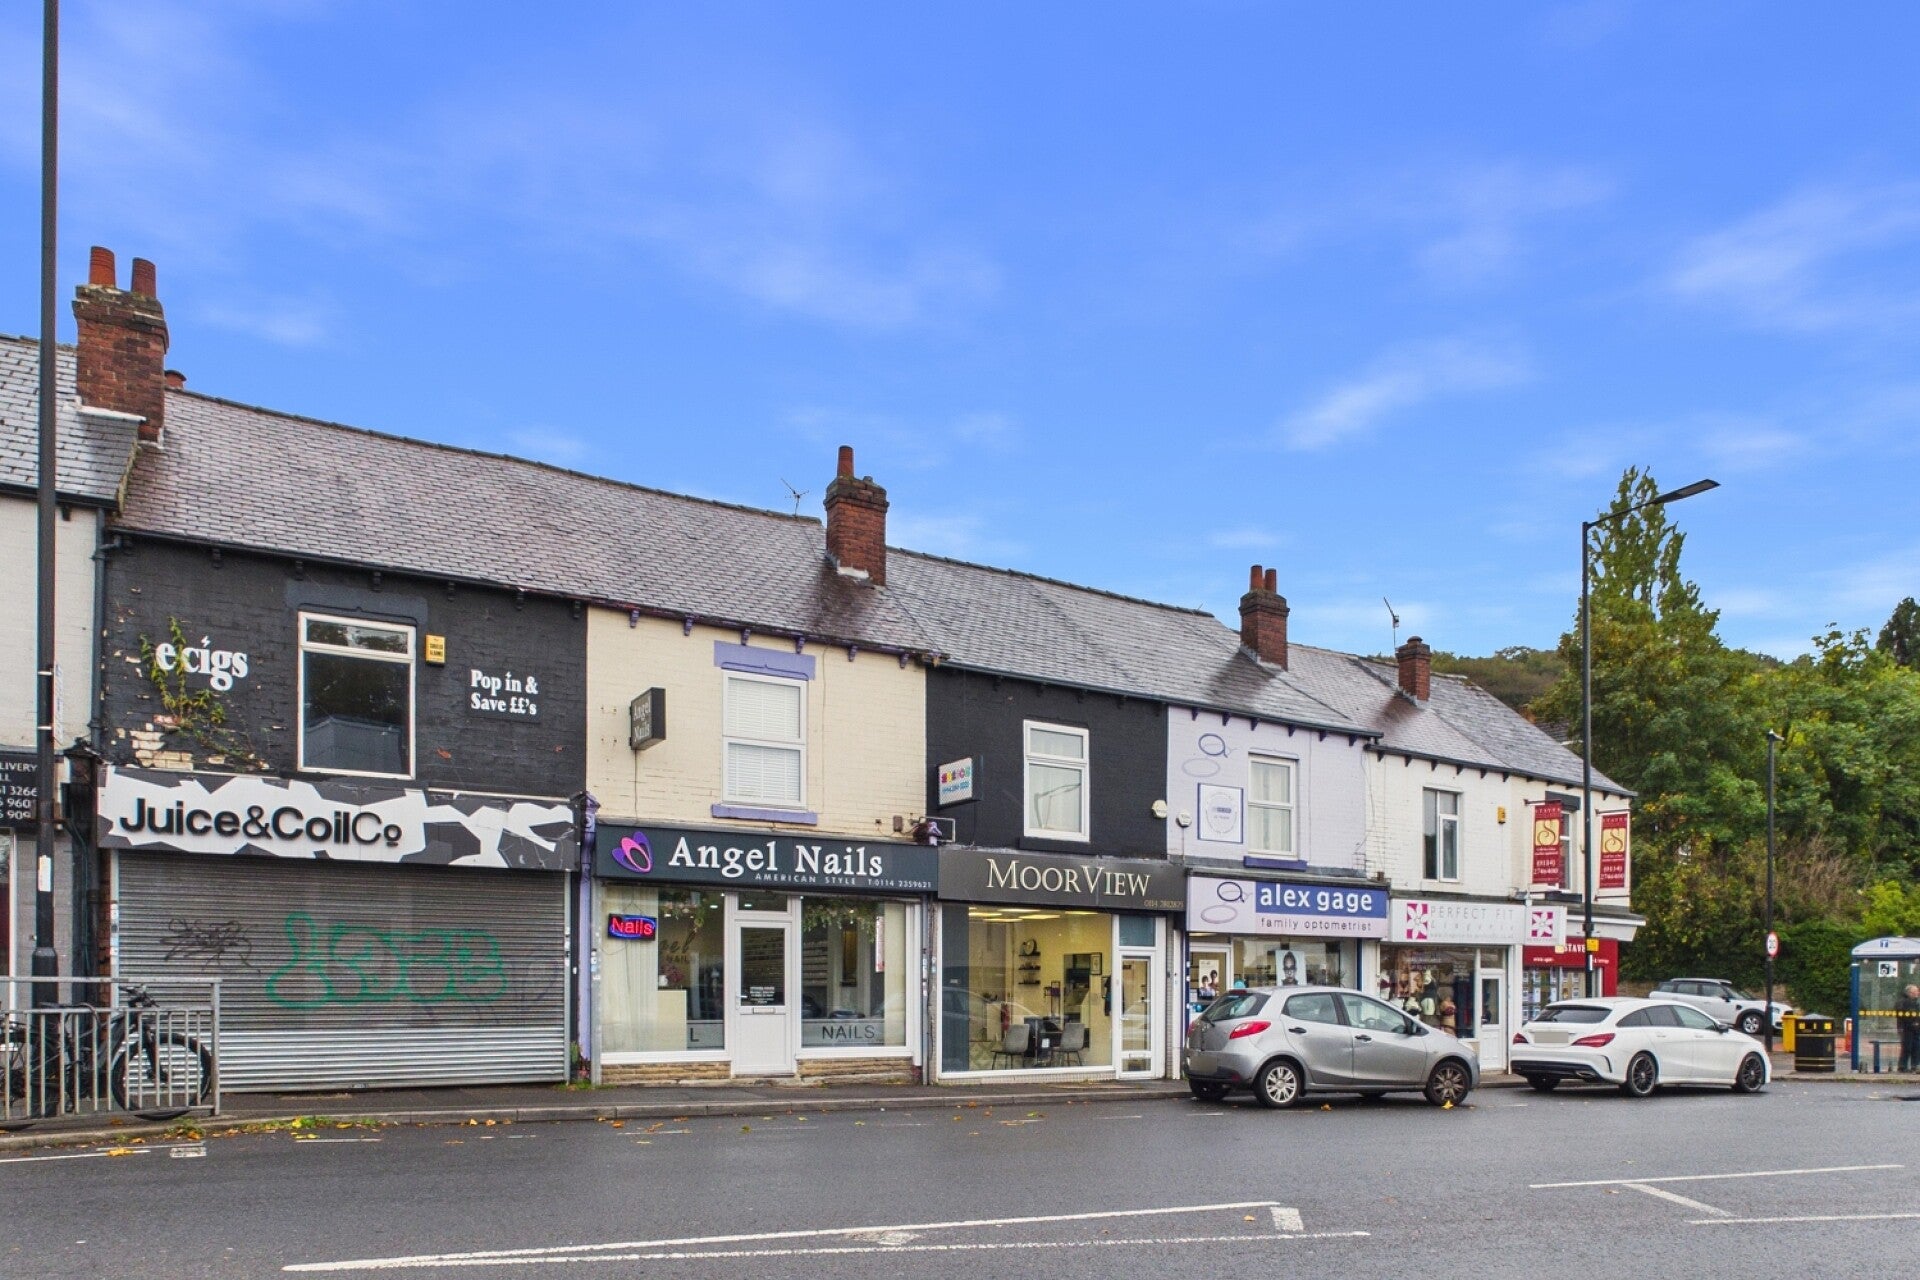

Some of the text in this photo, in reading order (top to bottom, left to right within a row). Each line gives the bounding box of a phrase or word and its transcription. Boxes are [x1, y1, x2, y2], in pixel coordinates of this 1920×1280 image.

[470, 669, 539, 697] Pop in &
[470, 692, 506, 712] Save
[668, 836, 883, 878] Angel Nails
[754, 872, 817, 883] AMERICAN
[824, 876, 856, 886] STYLE
[1260, 884, 1373, 913] alex gage
[1430, 906, 1515, 920] PERFECT FIT
[611, 917, 654, 936] Nails
[1261, 917, 1372, 932] family optometrist
[822, 1025, 875, 1040] NAILS
